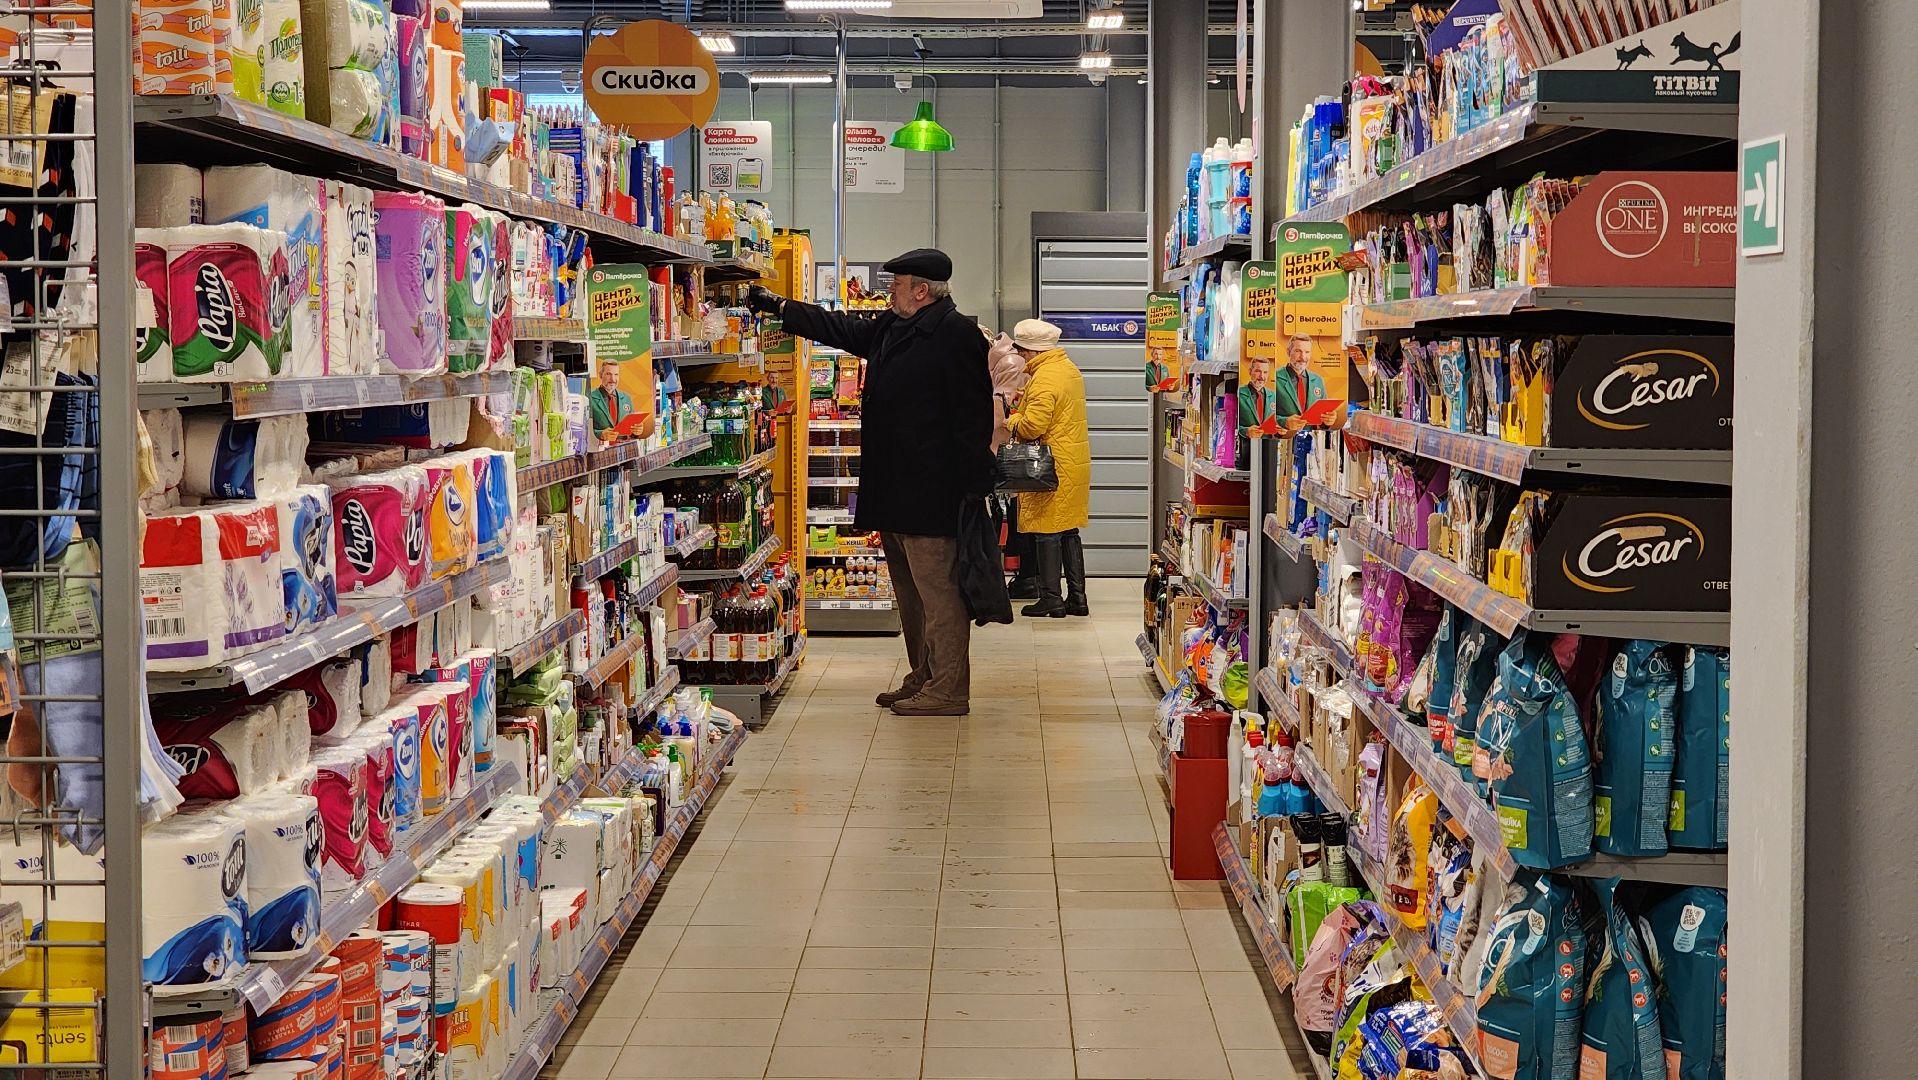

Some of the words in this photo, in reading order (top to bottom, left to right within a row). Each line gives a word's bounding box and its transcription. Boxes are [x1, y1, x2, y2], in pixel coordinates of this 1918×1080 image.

[186, 13, 212, 34] tolli
[154, 45, 190, 68] tolli
[601, 69, 696, 91] Скидка
[1652, 75, 1720, 91] TiTBiT
[1686, 90, 1712, 98] кусочек
[707, 128, 733, 137] Карта
[846, 128, 873, 136] ольше
[848, 145, 887, 153] очереди?
[1626, 199, 1656, 207] PURINA
[1605, 207, 1657, 230] ONE
[1299, 231, 1343, 241] Пятёрочка
[1285, 250, 1330, 268] ЦЕНТР
[1285, 259, 1342, 277] НИЗКИХ
[605, 273, 642, 281] Пятёрочка
[1285, 276, 1312, 289] ЦЕН
[595, 288, 632, 304] ЦЕНТР
[1248, 287, 1277, 299] ЦЕНТ
[195, 264, 236, 344] Papia
[595, 294, 642, 314] НИЗКИХ
[1248, 297, 1277, 309] НИЗК
[1150, 305, 1173, 314] ЦЕНТР
[1150, 310, 1178, 319] НИЗКИХ
[1248, 307, 1271, 319] ЦЕН
[595, 310, 618, 322] ЦЕН
[1150, 317, 1164, 325] ЦЕН
[1299, 315, 1337, 324] Выгодно
[1091, 323, 1120, 332] ТАБАК
[1718, 417, 1734, 427] ОТ
[341, 503, 376, 567] Papia
[442, 669, 455, 680] №1
[285, 823, 304, 835] 100%
[195, 850, 220, 863] 100%
